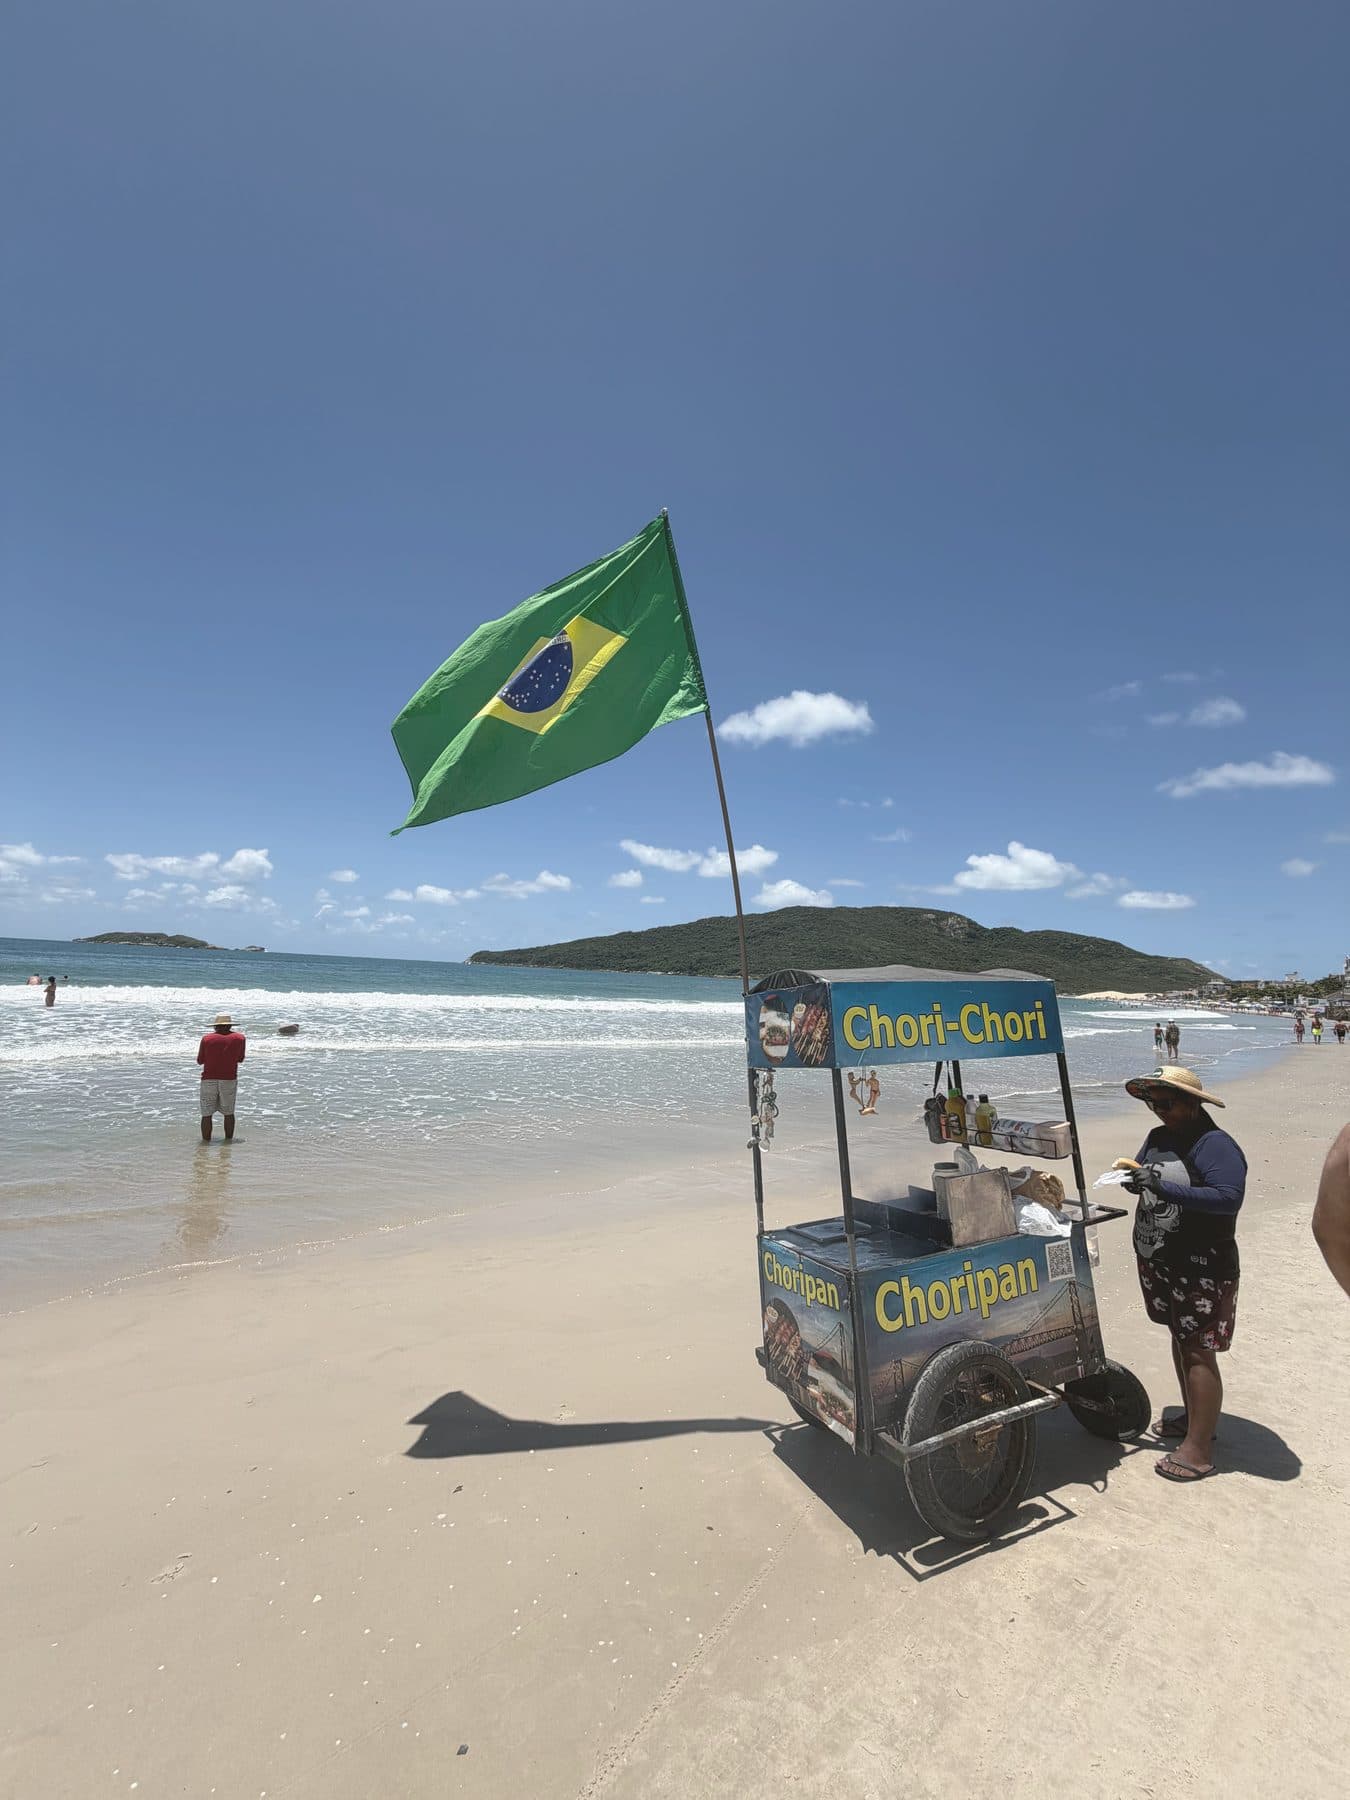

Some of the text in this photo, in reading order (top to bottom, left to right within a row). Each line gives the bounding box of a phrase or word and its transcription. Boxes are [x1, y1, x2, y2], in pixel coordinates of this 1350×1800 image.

[843, 1001, 1047, 1050] Chori-Chori
[763, 1251, 840, 1311] Choripan
[875, 1256, 1039, 1333] Choripan
